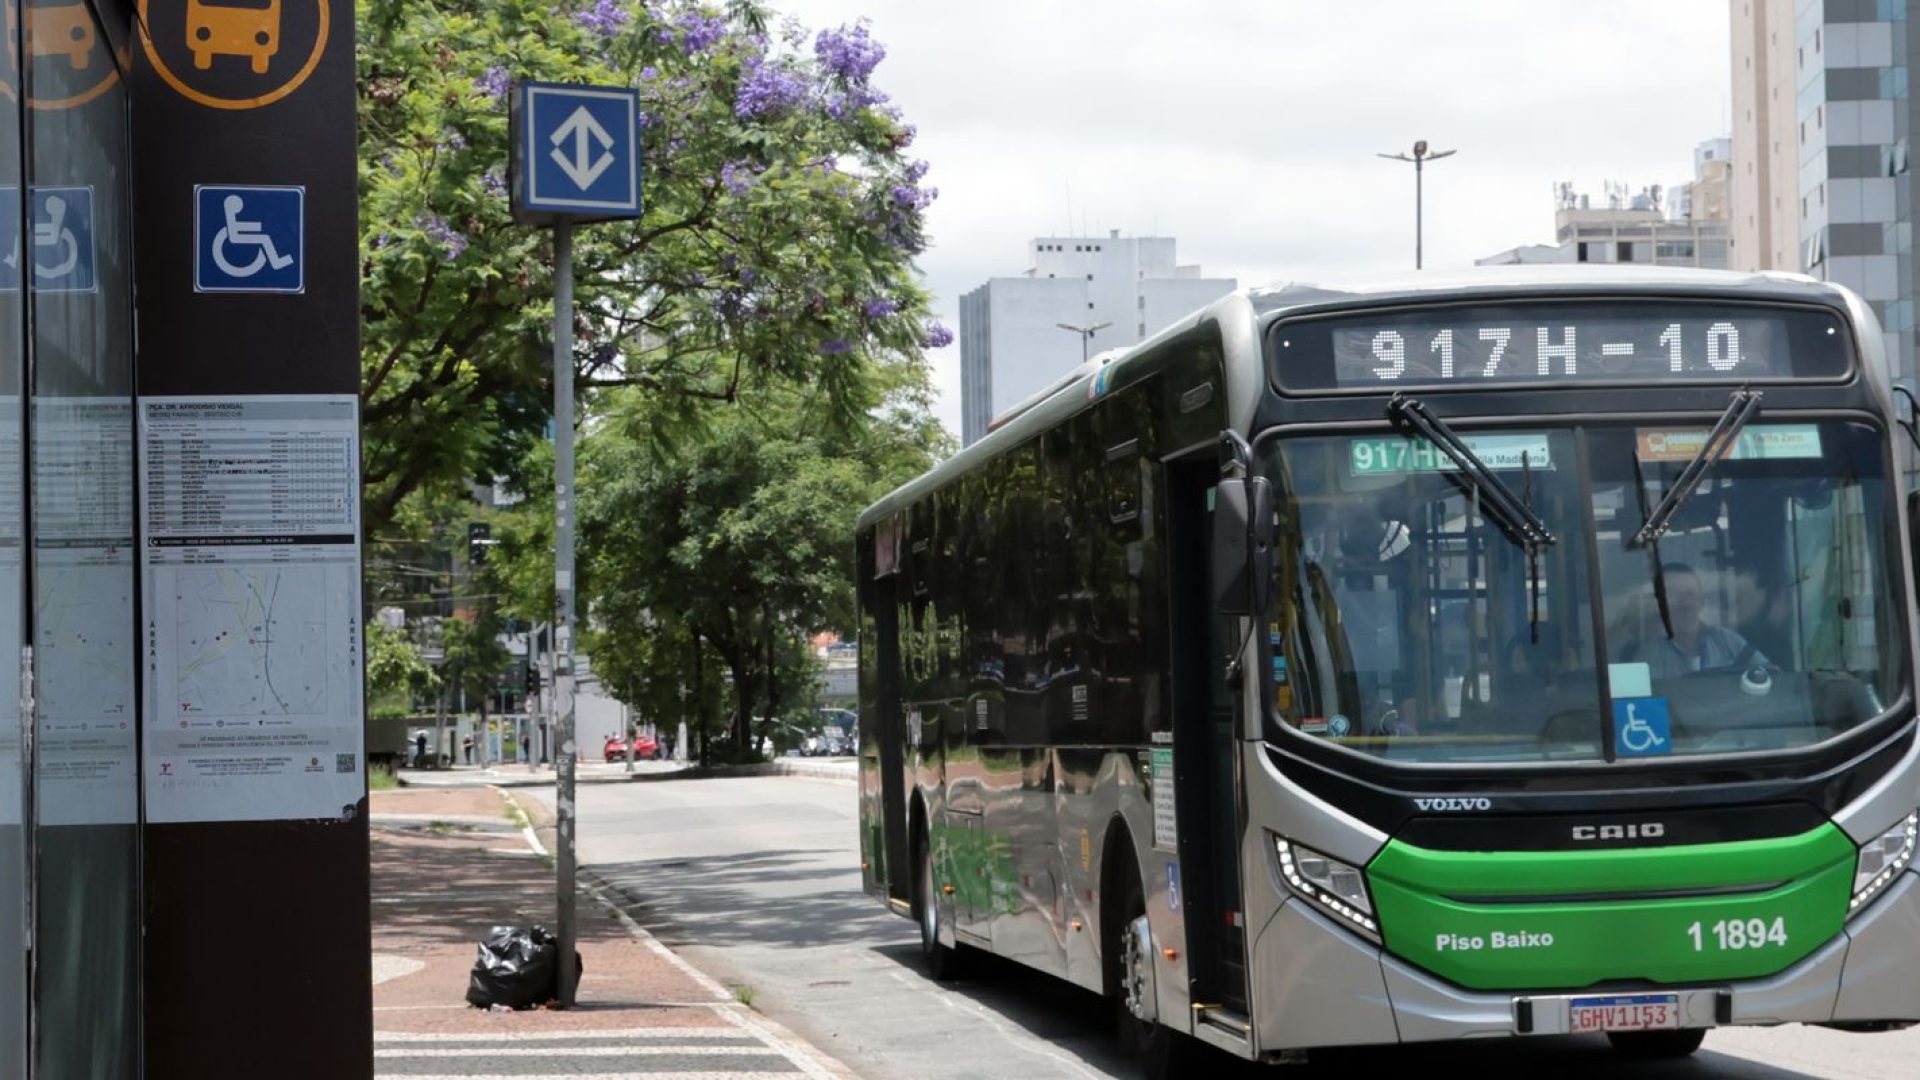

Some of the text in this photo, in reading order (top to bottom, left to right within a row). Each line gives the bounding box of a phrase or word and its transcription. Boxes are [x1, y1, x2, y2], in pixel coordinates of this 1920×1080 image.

[1371, 321, 1740, 380] 917H-10
[1354, 439, 1435, 470] 917H
[1496, 453, 1546, 465] Madaena
[1413, 797, 1492, 812] VOLVO
[1572, 822, 1665, 841] CAIO
[1436, 930, 1554, 952] Piso Baixo
[1713, 916, 1788, 950] 1894
